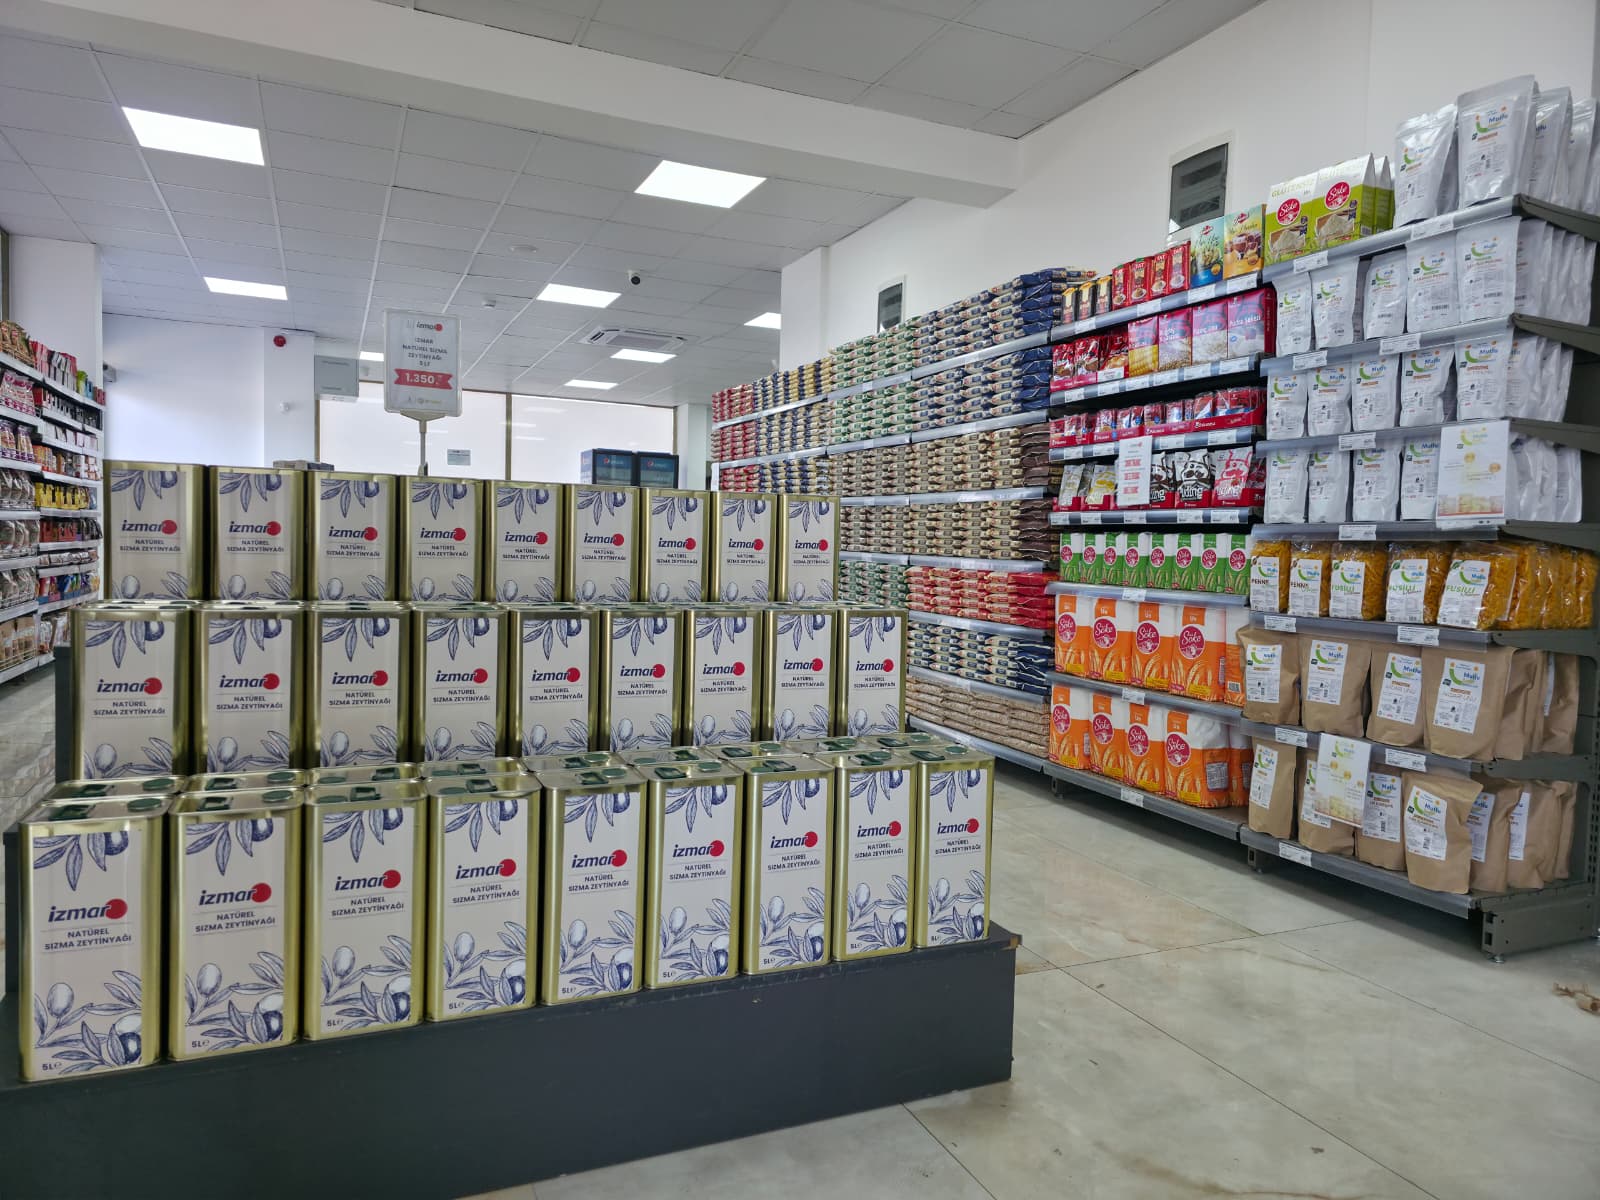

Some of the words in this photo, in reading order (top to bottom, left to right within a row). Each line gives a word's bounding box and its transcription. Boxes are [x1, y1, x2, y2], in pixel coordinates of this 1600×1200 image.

[122, 519, 166, 533] izmar
[229, 521, 270, 534] izmar
[329, 525, 368, 539] izmar
[420, 527, 457, 539] izmar
[505, 531, 539, 543] izmar
[584, 532, 616, 544] izmar
[658, 537, 688, 548] izmar
[728, 538, 757, 549] izmar
[795, 539, 821, 550] izmar
[703, 663, 736, 675] izmar
[783, 659, 815, 670] izmar
[856, 660, 886, 671] izmar
[436, 669, 477, 683] izmar
[532, 669, 571, 682] izmar
[620, 665, 656, 677] izmar
[219, 674, 268, 688] izmar
[332, 671, 377, 685] izmar
[97, 679, 149, 693] izmar
[857, 825, 892, 838] izmar
[937, 822, 970, 835] izmar
[770, 836, 808, 849] izmar
[673, 844, 714, 858] izmar
[571, 854, 616, 869] izmar
[684, 863, 711, 871] NATÜREL
[456, 864, 504, 880] izmar
[584, 874, 613, 882] NATÜREL
[335, 875, 388, 892] izmar
[470, 884, 502, 894] NATÜREL
[568, 884, 589, 892] SIZMA
[199, 889, 257, 906] izmar
[350, 896, 385, 906] NATÜREL
[453, 895, 476, 904] SIZMA
[48, 905, 111, 923] izmar
[216, 911, 254, 921] NATÜREL
[331, 908, 356, 917] SIZMA
[195, 923, 223, 932] SIZMA
[225, 917, 275, 930] ZEYTİNYAĞI
[67, 928, 108, 939] NATÜREL
[45, 940, 74, 950] SIZMA
[76, 934, 132, 947] ZEYTİNYAĞI
